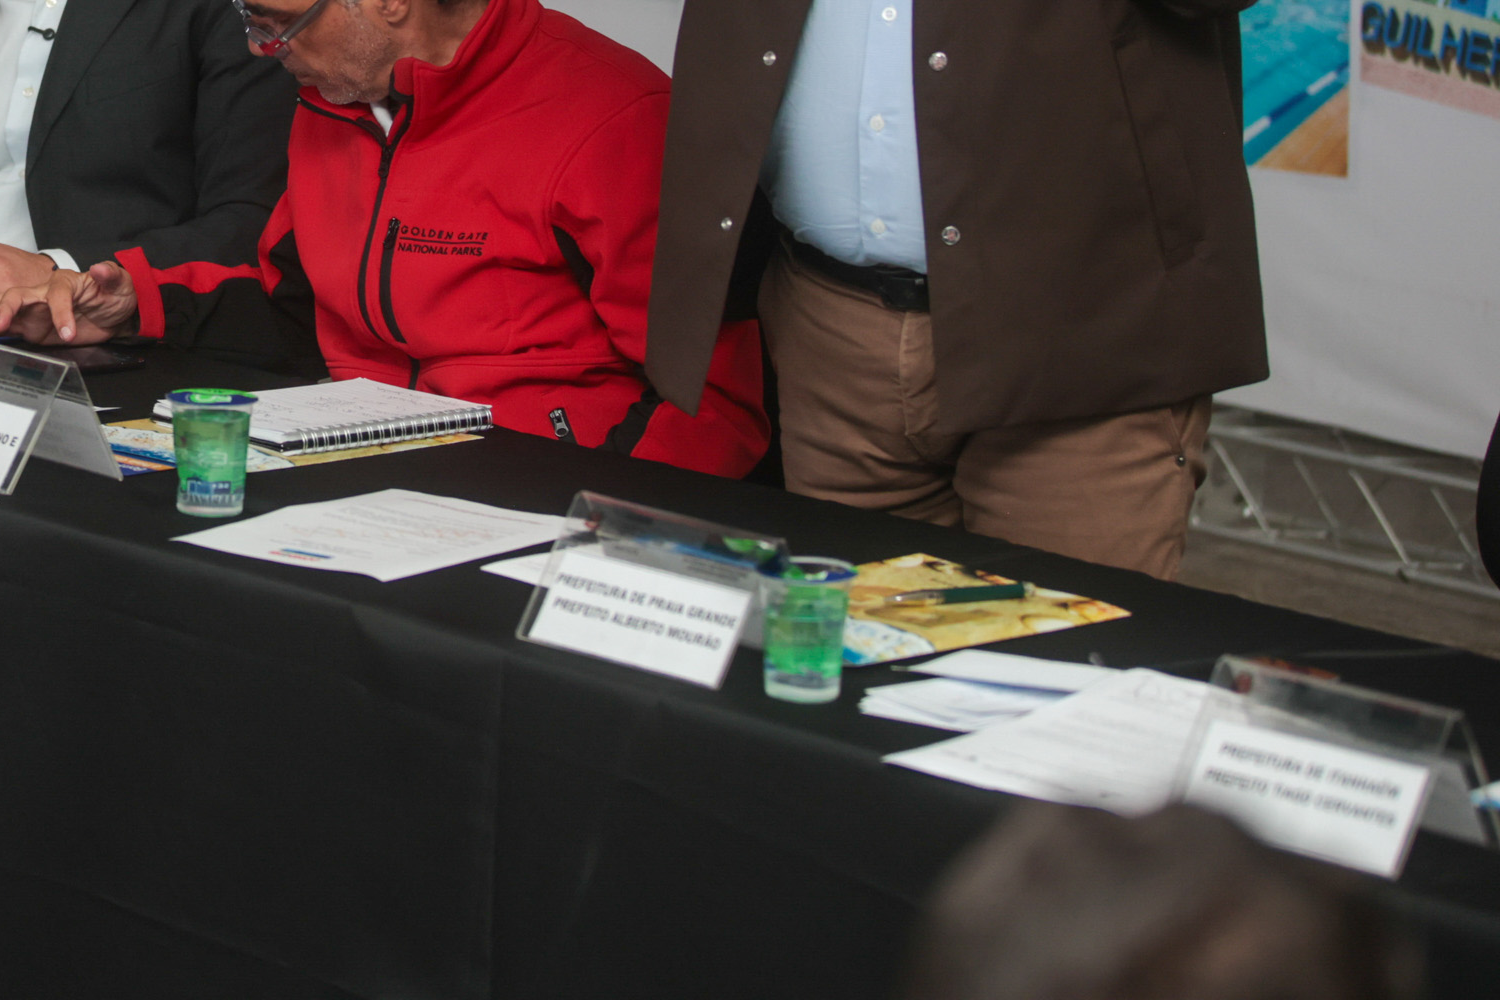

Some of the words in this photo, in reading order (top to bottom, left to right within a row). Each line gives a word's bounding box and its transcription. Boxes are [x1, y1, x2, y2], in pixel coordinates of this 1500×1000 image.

[400, 225, 453, 240] GOLDEN
[457, 232, 489, 241] GATE
[397, 243, 448, 255] NATIONAL
[451, 246, 483, 257] PARKS
[9, 436, 18, 447] E
[556, 572, 628, 602] PREFEITURA
[629, 591, 645, 606] DE
[648, 595, 685, 614] PRAIA
[687, 604, 738, 629] GRANDE
[553, 597, 609, 620] PREFEITO
[611, 612, 665, 636] ALBERTO
